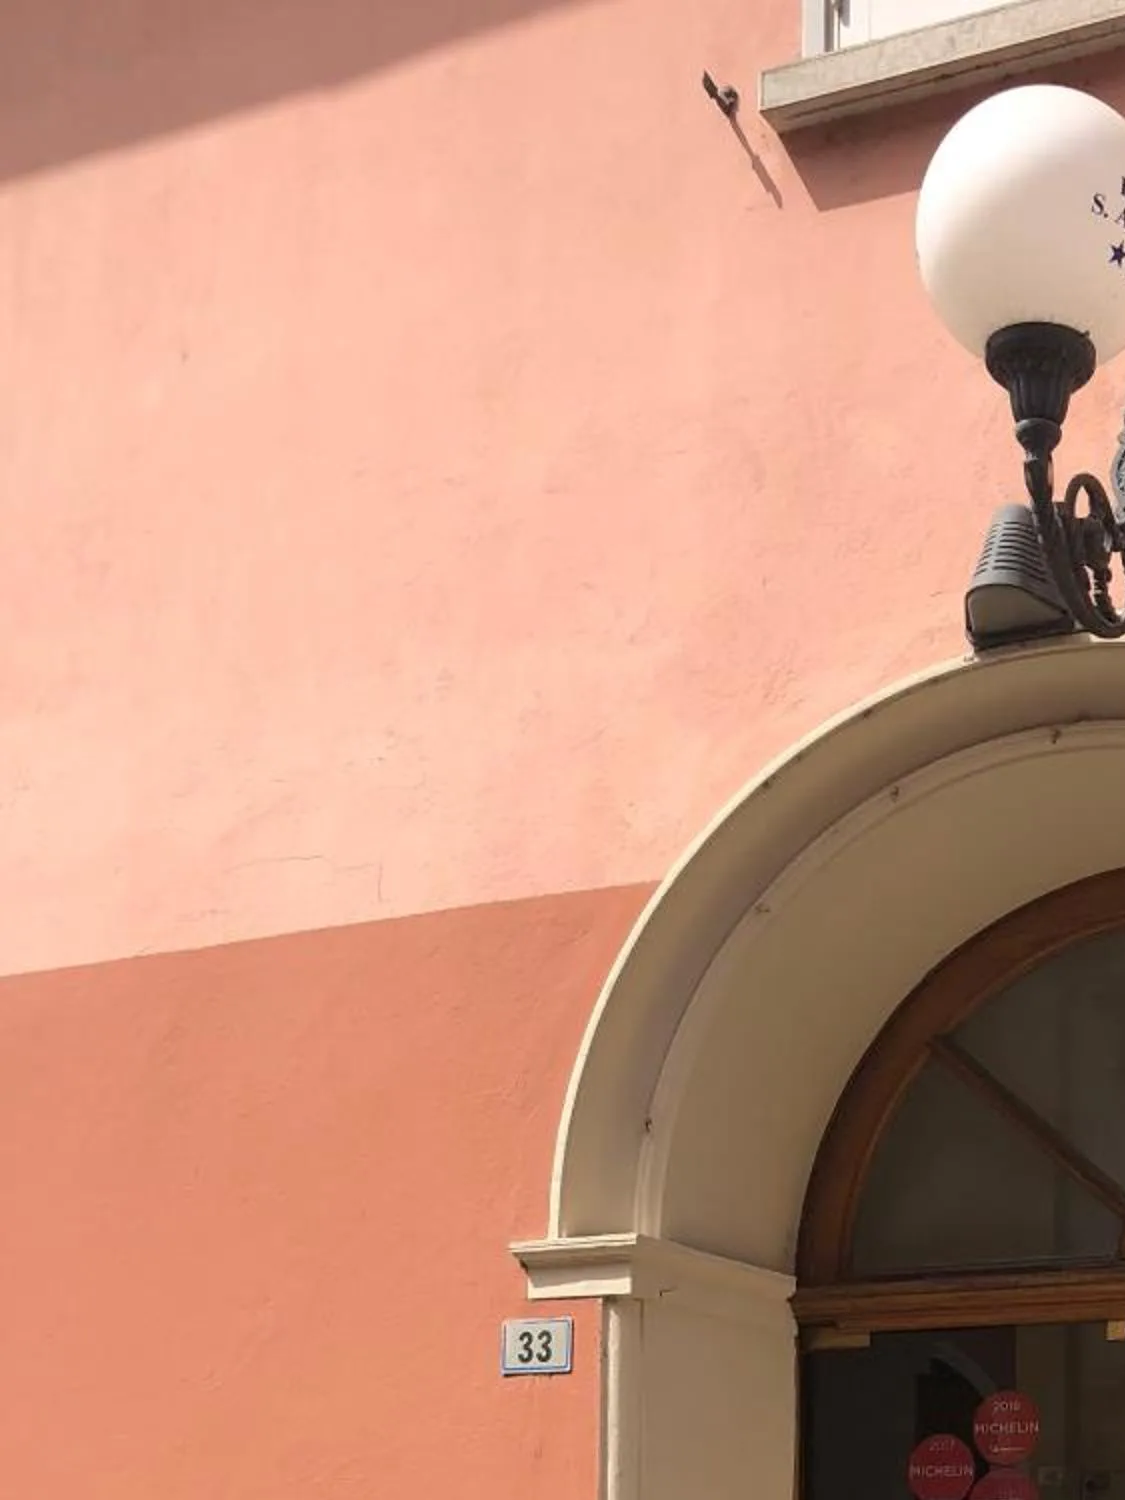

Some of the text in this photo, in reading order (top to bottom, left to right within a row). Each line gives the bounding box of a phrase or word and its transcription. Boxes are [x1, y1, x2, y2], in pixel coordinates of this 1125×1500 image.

[1091, 192, 1108, 218] S.
[518, 1330, 552, 1363] 33
[974, 1420, 1039, 1434] MICHELIN
[909, 1464, 973, 1479] MICHELIN
